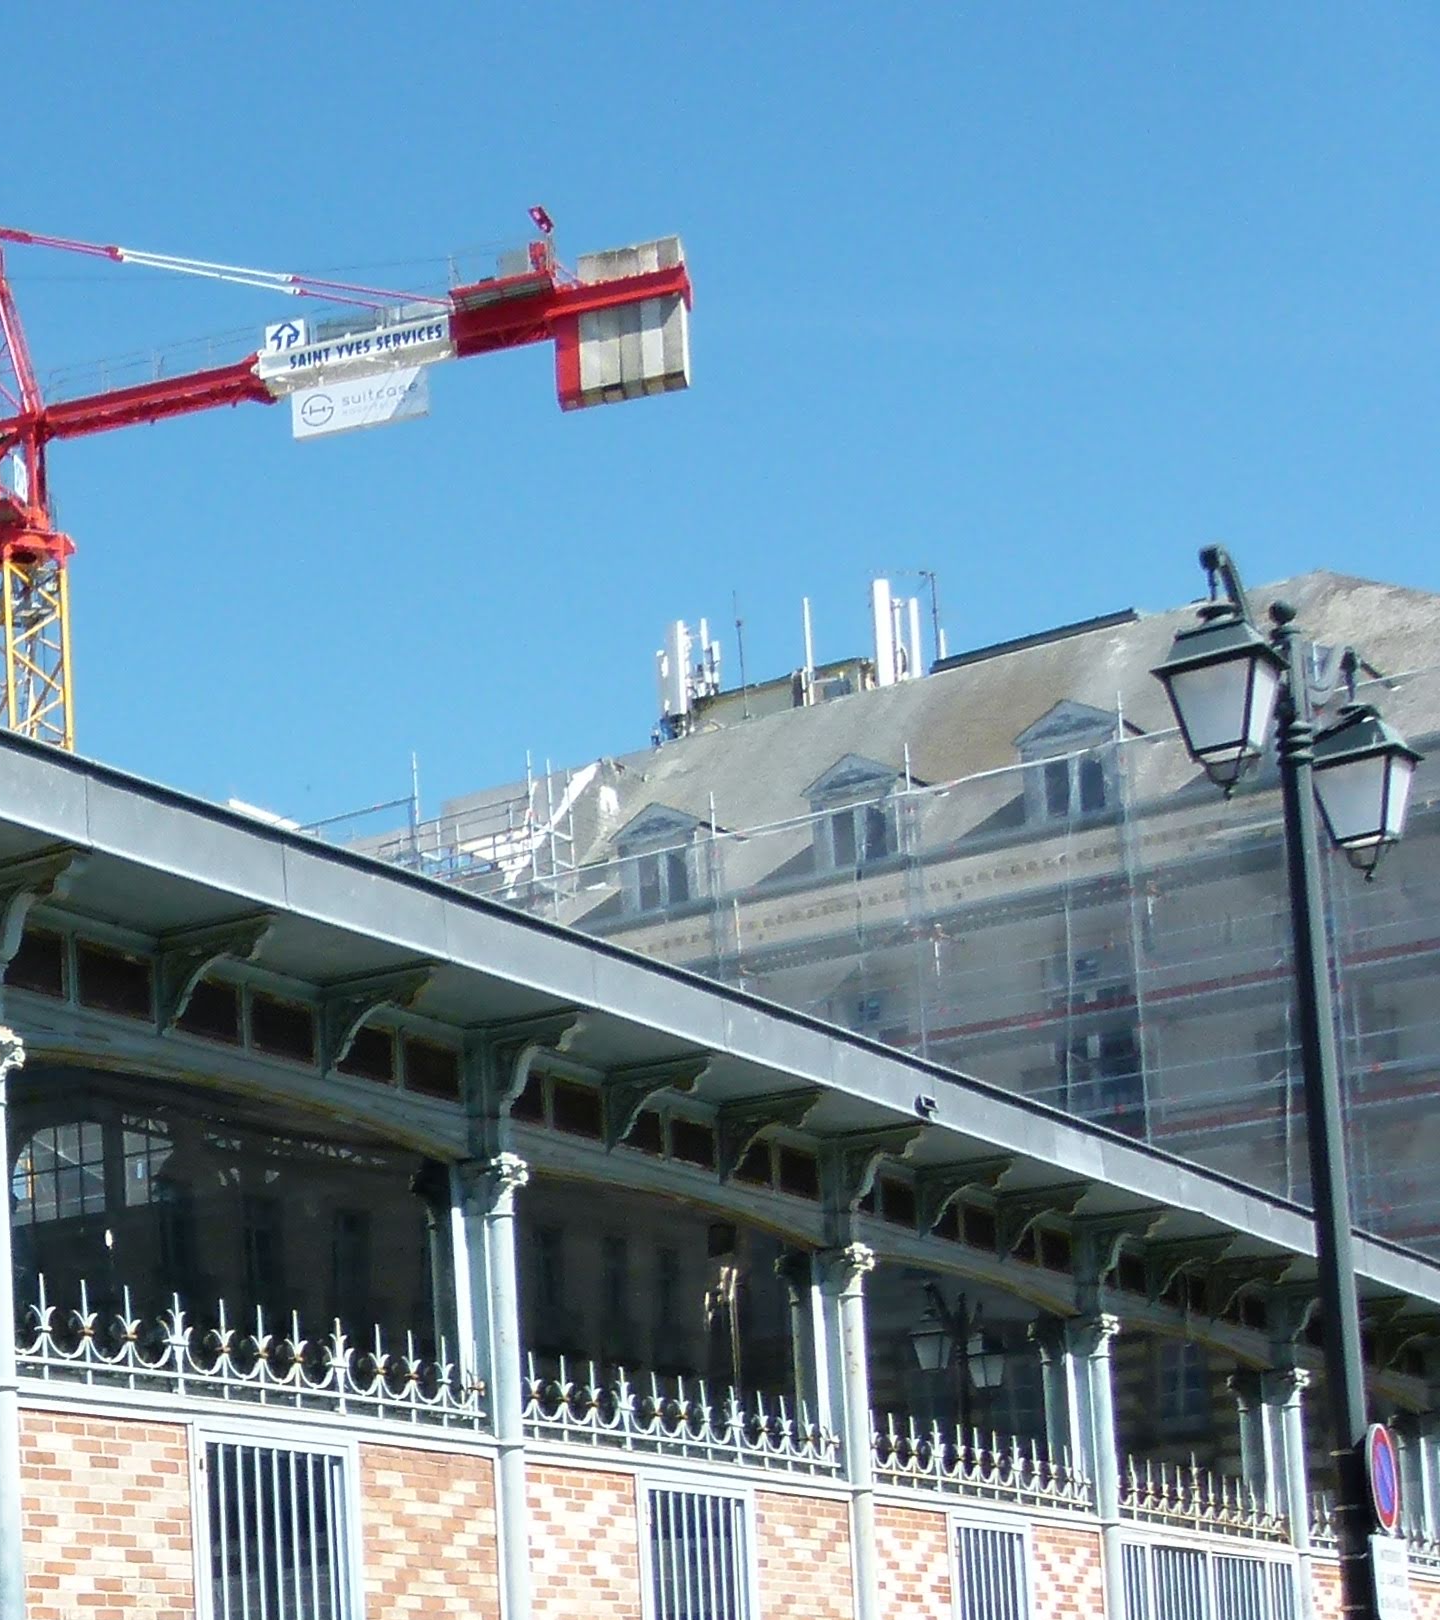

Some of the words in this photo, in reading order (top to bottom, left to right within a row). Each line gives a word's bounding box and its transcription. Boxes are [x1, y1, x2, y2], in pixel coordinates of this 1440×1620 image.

[290, 348, 330, 370] SAINT
[336, 338, 371, 360] YVES
[376, 323, 443, 349] SERVICES
[341, 381, 418, 407] suitcase
